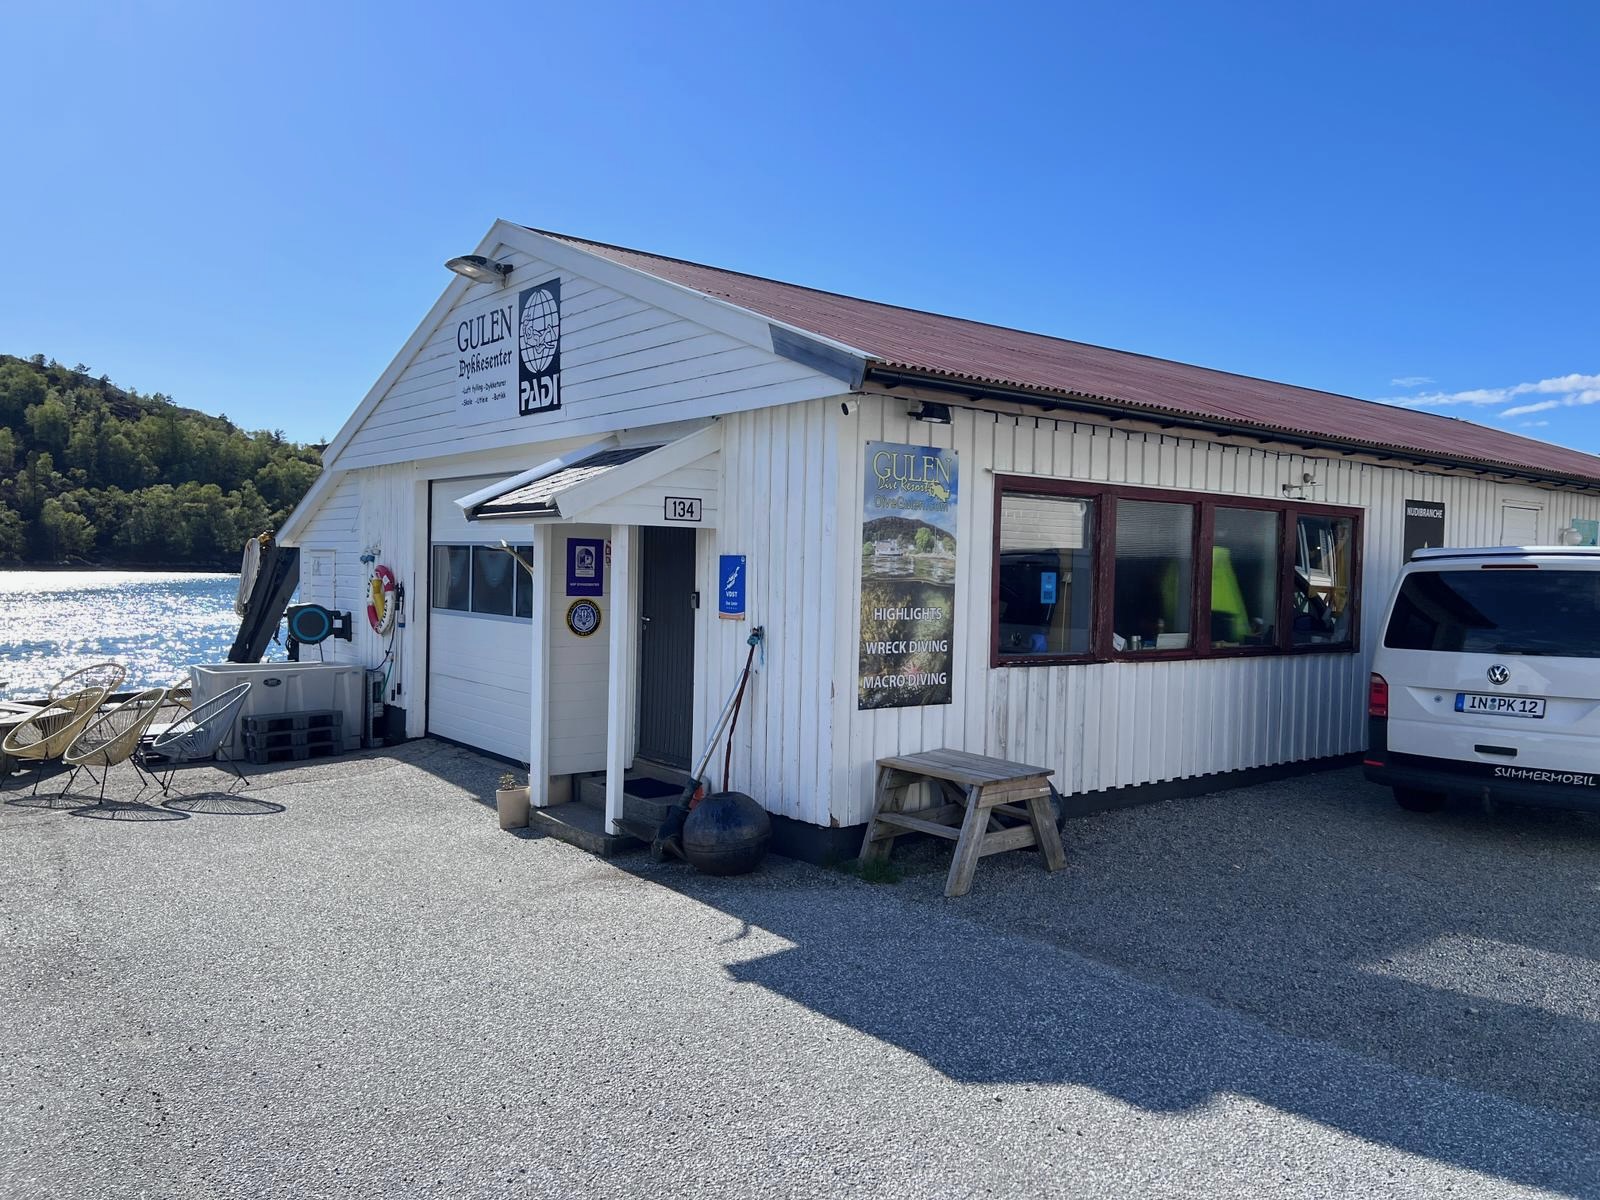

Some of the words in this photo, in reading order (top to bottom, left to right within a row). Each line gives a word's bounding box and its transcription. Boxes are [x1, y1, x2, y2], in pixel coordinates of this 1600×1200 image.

[457, 305, 513, 353] GULEN
[458, 350, 513, 380] Dykkesenter
[520, 373, 560, 411] PADI
[873, 450, 952, 484] GULEN
[878, 477, 897, 490] Dive
[900, 479, 929, 493] Resort
[672, 501, 694, 518] 134
[874, 607, 942, 621] HIGHLIGHTS
[866, 640, 907, 655] WRECK
[909, 640, 948, 653] DIVING
[863, 674, 906, 689] MACRO
[908, 672, 947, 686] DIVING
[1469, 696, 1488, 710] IN
[1497, 698, 1517, 712] PK
[1518, 700, 1538, 714] 12
[1494, 767, 1597, 786] SUMMERMOBIL
